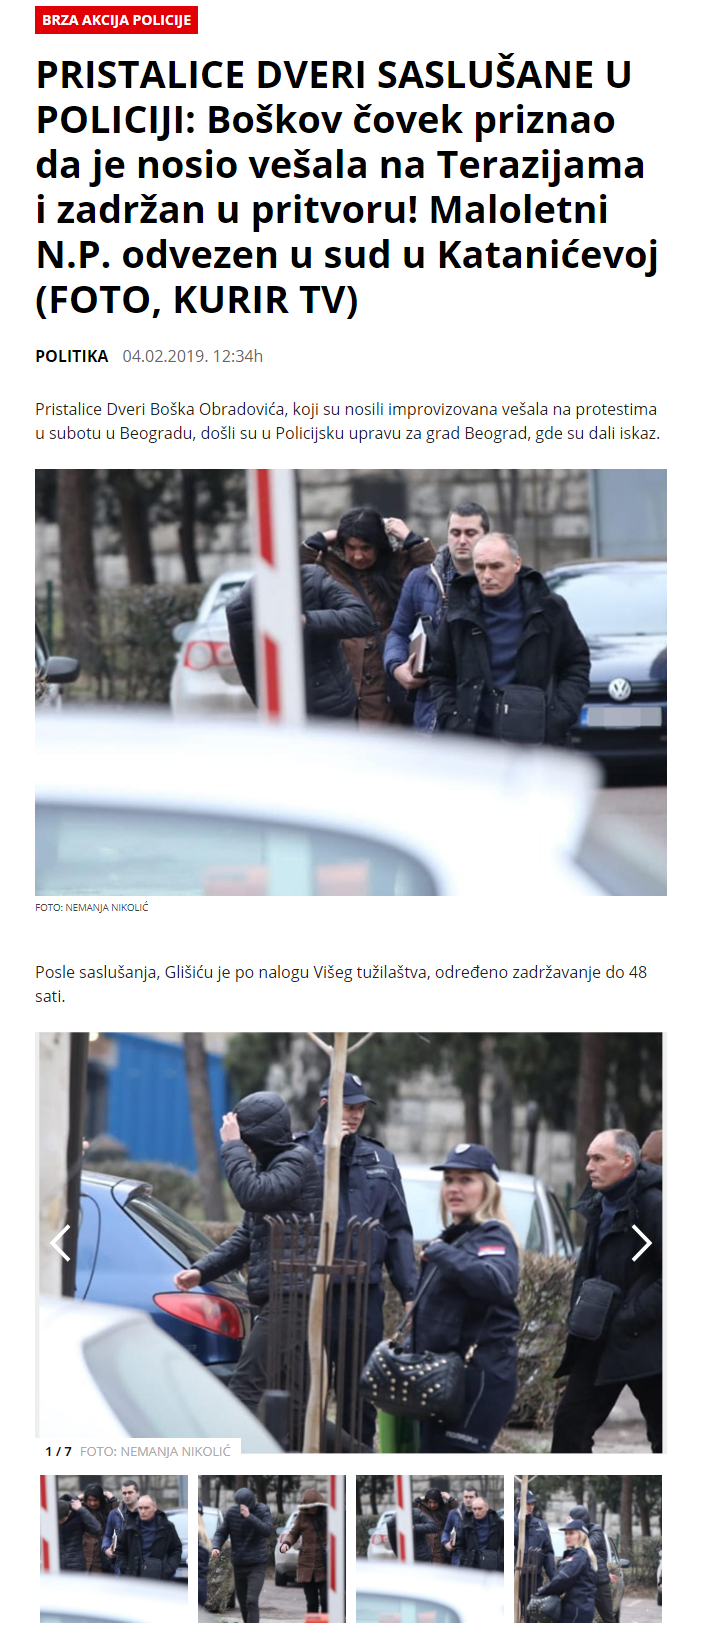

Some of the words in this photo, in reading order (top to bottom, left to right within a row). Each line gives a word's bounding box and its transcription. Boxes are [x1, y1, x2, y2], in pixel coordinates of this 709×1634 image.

[42, 14, 80, 26] BRZA
[81, 14, 130, 29] AKCIJA
[133, 14, 192, 29] POLICIJE
[37, 60, 244, 89] PRISTALICE
[257, 60, 365, 89] DVERI
[377, 52, 593, 89] SASLUŠANE
[606, 60, 631, 89] U
[37, 105, 195, 142] POLICIJI:
[208, 103, 344, 134] Boškov
[353, 103, 464, 134] čovek
[475, 103, 615, 143] priznao
[35, 148, 80, 179] da
[88, 148, 126, 188] je
[138, 148, 238, 179] nosio
[247, 148, 367, 179] vešala
[380, 156, 425, 179] na
[436, 148, 644, 188] Terazijama
[36, 193, 45, 224] i
[56, 193, 204, 224] zadržan
[217, 201, 239, 224] u
[252, 193, 417, 233] pritvoru!
[430, 193, 607, 224] Maloletni
[37, 240, 110, 269] N.P.
[122, 238, 277, 269] odvezen
[290, 246, 312, 269] u
[324, 238, 390, 269] sud
[403, 246, 425, 269] u
[439, 238, 658, 278] Katanićevoj
[35, 285, 161, 320] (FOTO,
[174, 285, 290, 314] KURIR
[298, 285, 358, 320] TV)
[35, 349, 110, 363] POLITIKA
[122, 349, 209, 363] 04.02.2019.
[213, 348, 263, 363] 12:34h
[35, 401, 102, 416] Pristalice
[107, 402, 146, 416] Dveri
[150, 401, 195, 416] Boška
[199, 401, 289, 418] Obradovića,
[293, 401, 319, 420] koji
[323, 405, 340, 416] su
[345, 401, 384, 416] nosili
[388, 402, 498, 420] improvizovana
[501, 401, 548, 416] vešala
[553, 405, 571, 416] na
[575, 402, 657, 420] protestima
[35, 903, 64, 912] FOTO:
[65, 903, 110, 914] NEMANJA
[111, 900, 149, 912] NIKOLIĆ
[35, 964, 75, 979] Posle
[79, 964, 161, 983] saslušanja,
[164, 964, 213, 979] Glišiću
[215, 965, 231, 983] je
[235, 968, 255, 983] po
[258, 964, 309, 983] nalogu
[312, 964, 353, 983] Višeg
[356, 964, 431, 981] tužilaštva,
[434, 964, 509, 979] određeno
[512, 964, 601, 983] zadržavanje
[605, 964, 625, 979] do
[628, 965, 648, 979] 48
[35, 989, 66, 1003] sati.
